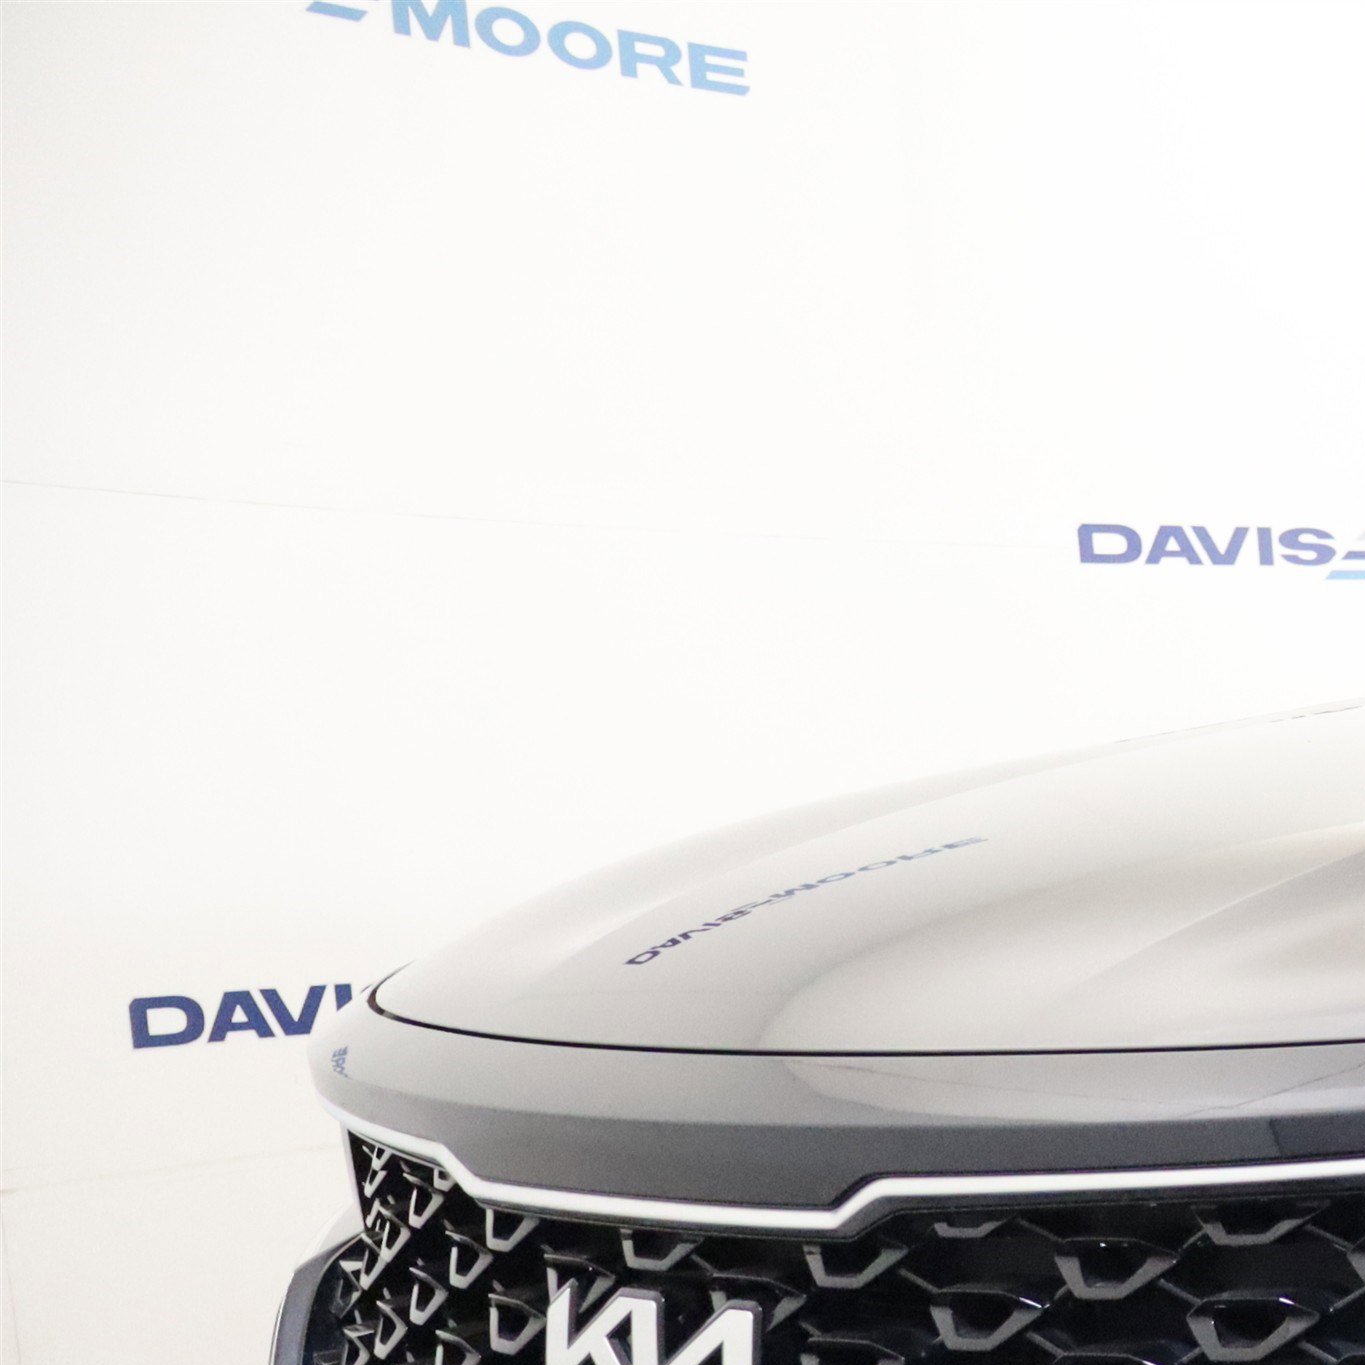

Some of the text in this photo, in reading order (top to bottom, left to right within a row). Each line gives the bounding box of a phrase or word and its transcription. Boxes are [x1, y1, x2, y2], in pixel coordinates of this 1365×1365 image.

[393, 0, 751, 97] MOORE
[1077, 523, 1338, 566] DAVIS
[128, 983, 353, 1049] DAV
